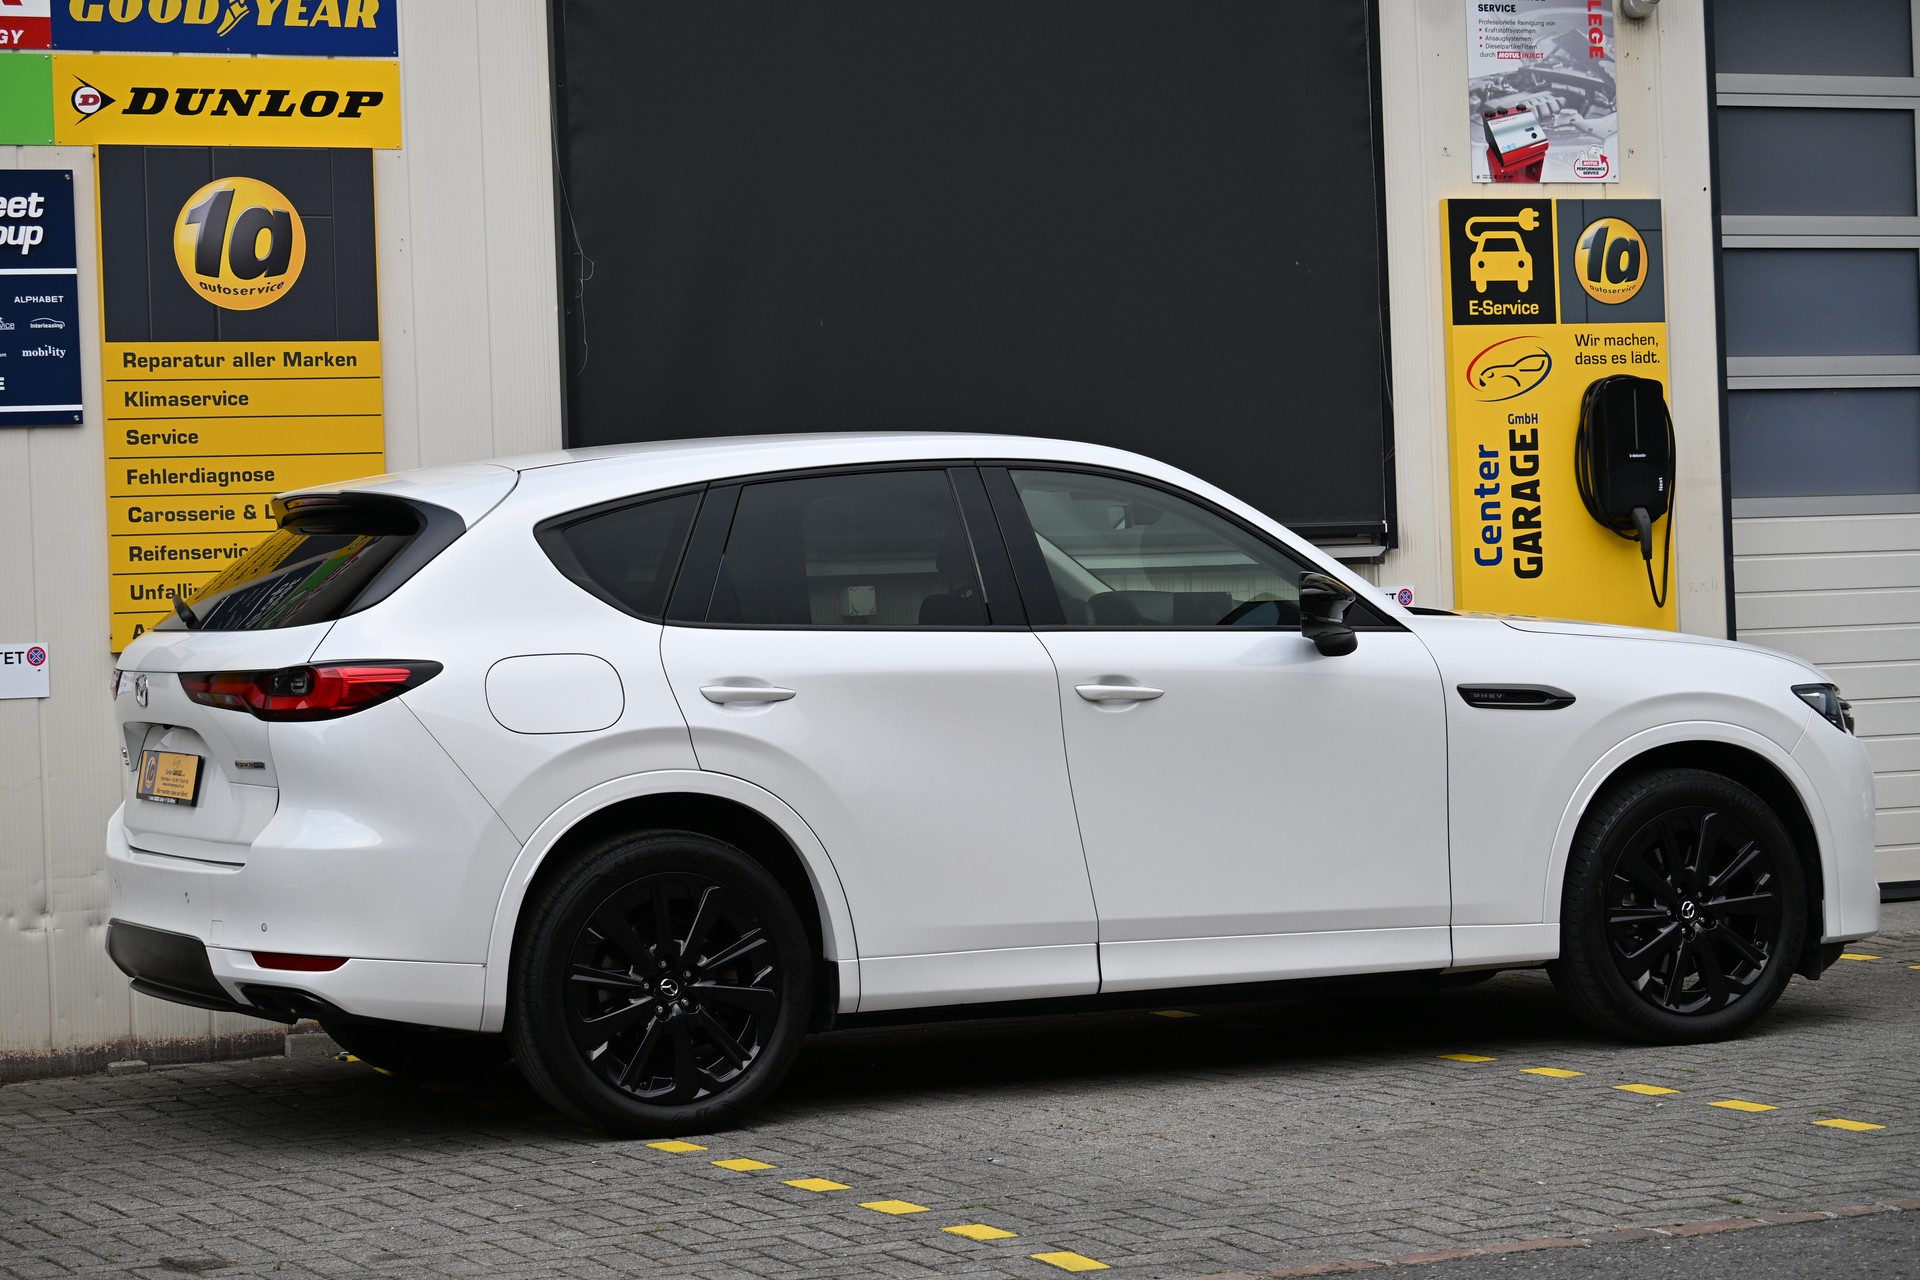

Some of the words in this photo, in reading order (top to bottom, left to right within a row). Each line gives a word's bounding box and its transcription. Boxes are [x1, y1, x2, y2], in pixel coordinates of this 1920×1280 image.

[1477, 4, 1516, 13] SERVICE
[1517, 20, 1545, 28] Reinigung
[0, 29, 24, 44] GY
[122, 87, 383, 118] DUNLOP
[185, 188, 293, 281] 1a
[1581, 225, 1641, 284] 1a
[199, 280, 285, 296] autoservice
[1589, 284, 1637, 294] autoservice
[14, 295, 64, 303] ALPHABET
[1469, 299, 1540, 316] E-Service
[1574, 333, 1600, 347] Wir
[1604, 333, 1659, 348] machen,
[22, 344, 66, 358] mobility
[1574, 351, 1608, 365] dass
[1611, 354, 1627, 365] es
[1630, 351, 1661, 364] lädt.
[123, 352, 225, 372] Reparatur
[232, 352, 276, 368] aller
[283, 351, 357, 368] Marken
[124, 390, 249, 407] Klimaservice
[1507, 413, 1539, 424] GmbH
[125, 429, 199, 446] Service
[126, 468, 275, 487] Fehlerdiagnose
[1473, 444, 1503, 567] Center
[1509, 428, 1543, 579] GARAGE
[128, 505, 236, 523] Carosserie
[243, 504, 257, 520] &
[129, 543, 253, 562] Reifenservic
[0, 651, 24, 665] ET
